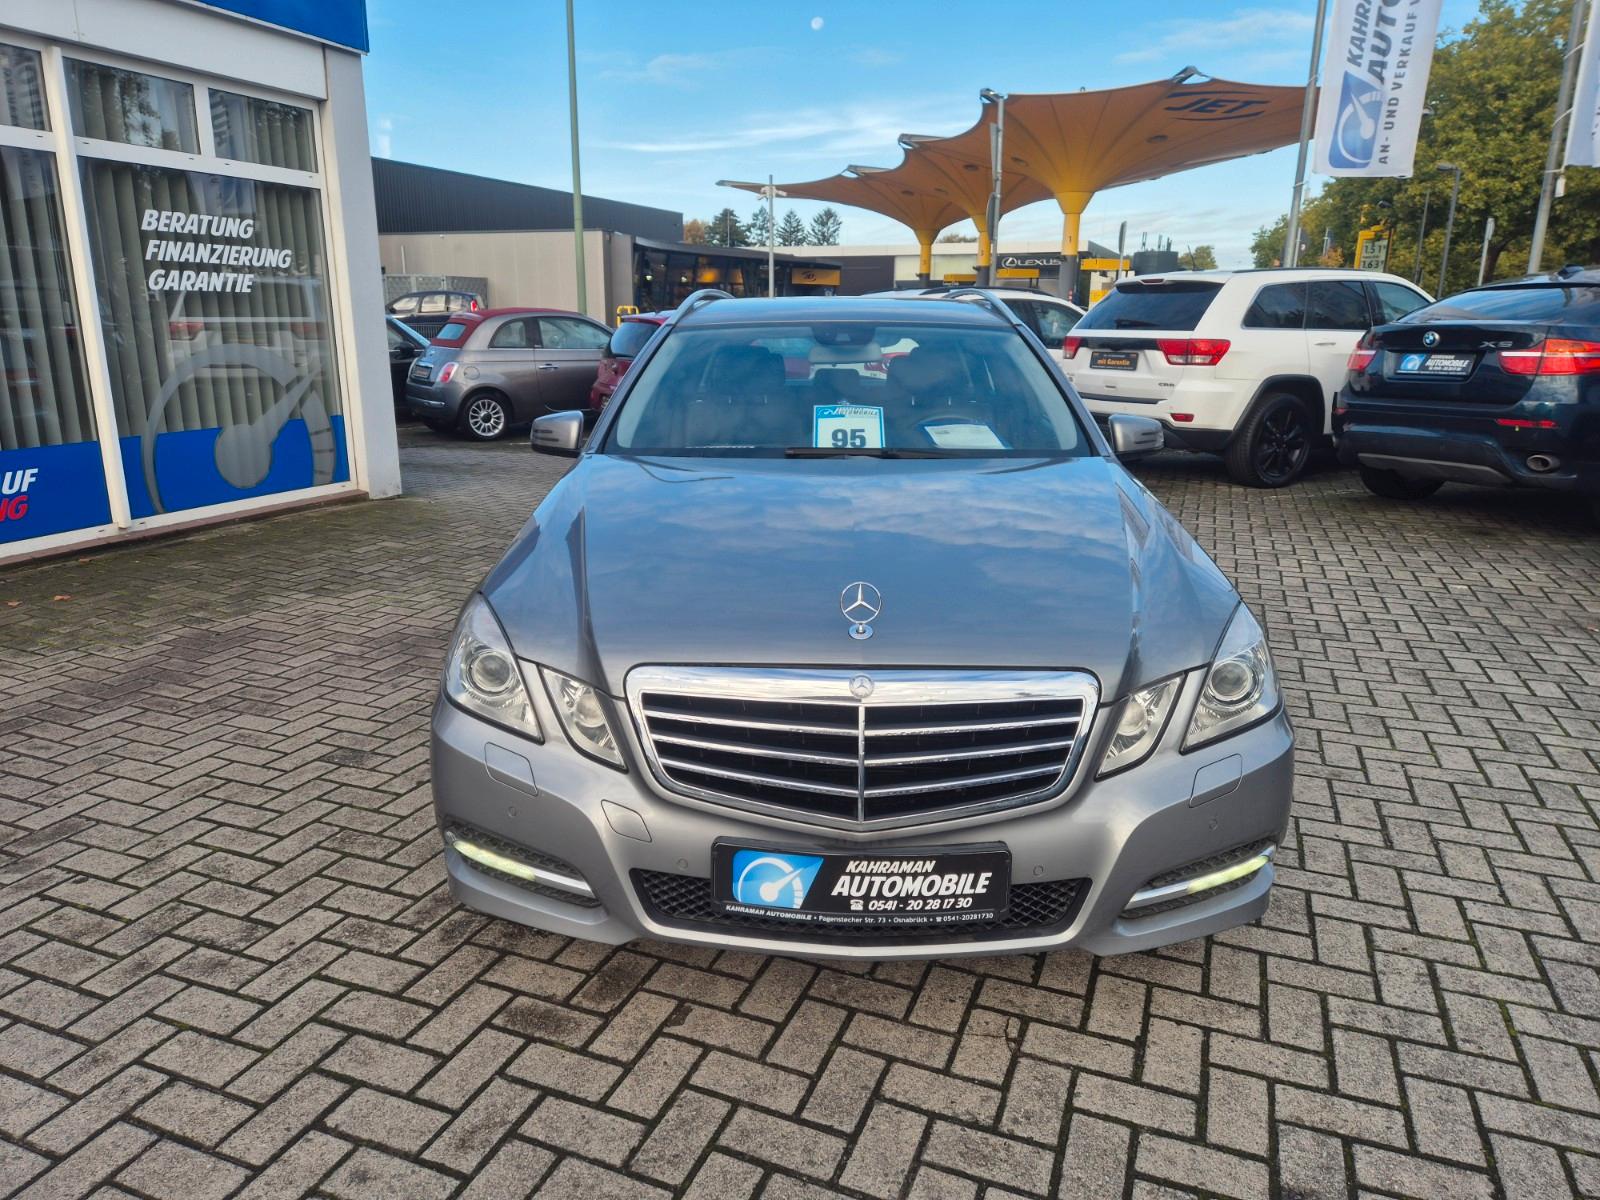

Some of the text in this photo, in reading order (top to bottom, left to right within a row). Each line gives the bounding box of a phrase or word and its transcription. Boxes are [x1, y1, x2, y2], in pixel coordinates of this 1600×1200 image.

[1391, 12, 1417, 91] VERKAUF
[1163, 98, 1272, 114] JET
[1383, 97, 1400, 130] UND
[141, 209, 254, 239] BERATUNG
[145, 239, 292, 268] FINANZIERUNG
[1017, 258, 1062, 266] LEXUS
[148, 269, 255, 293] GARANTIE
[831, 428, 867, 448] 95
[2, 468, 39, 495] UF
[845, 860, 936, 874] KAHRAMAN
[830, 872, 993, 897] AUTOMOBILE
[725, 904, 765, 915] KAHRAMAN
[766, 910, 812, 920] AUTOMOBILE
[818, 915, 863, 924] Pagenstecher
[943, 912, 994, 922] 0541-20281730
[868, 900, 898, 911] 0541
[906, 899, 923, 910] 20
[924, 899, 942, 910] 28
[943, 898, 955, 909] 17
[955, 898, 973, 909] 30
